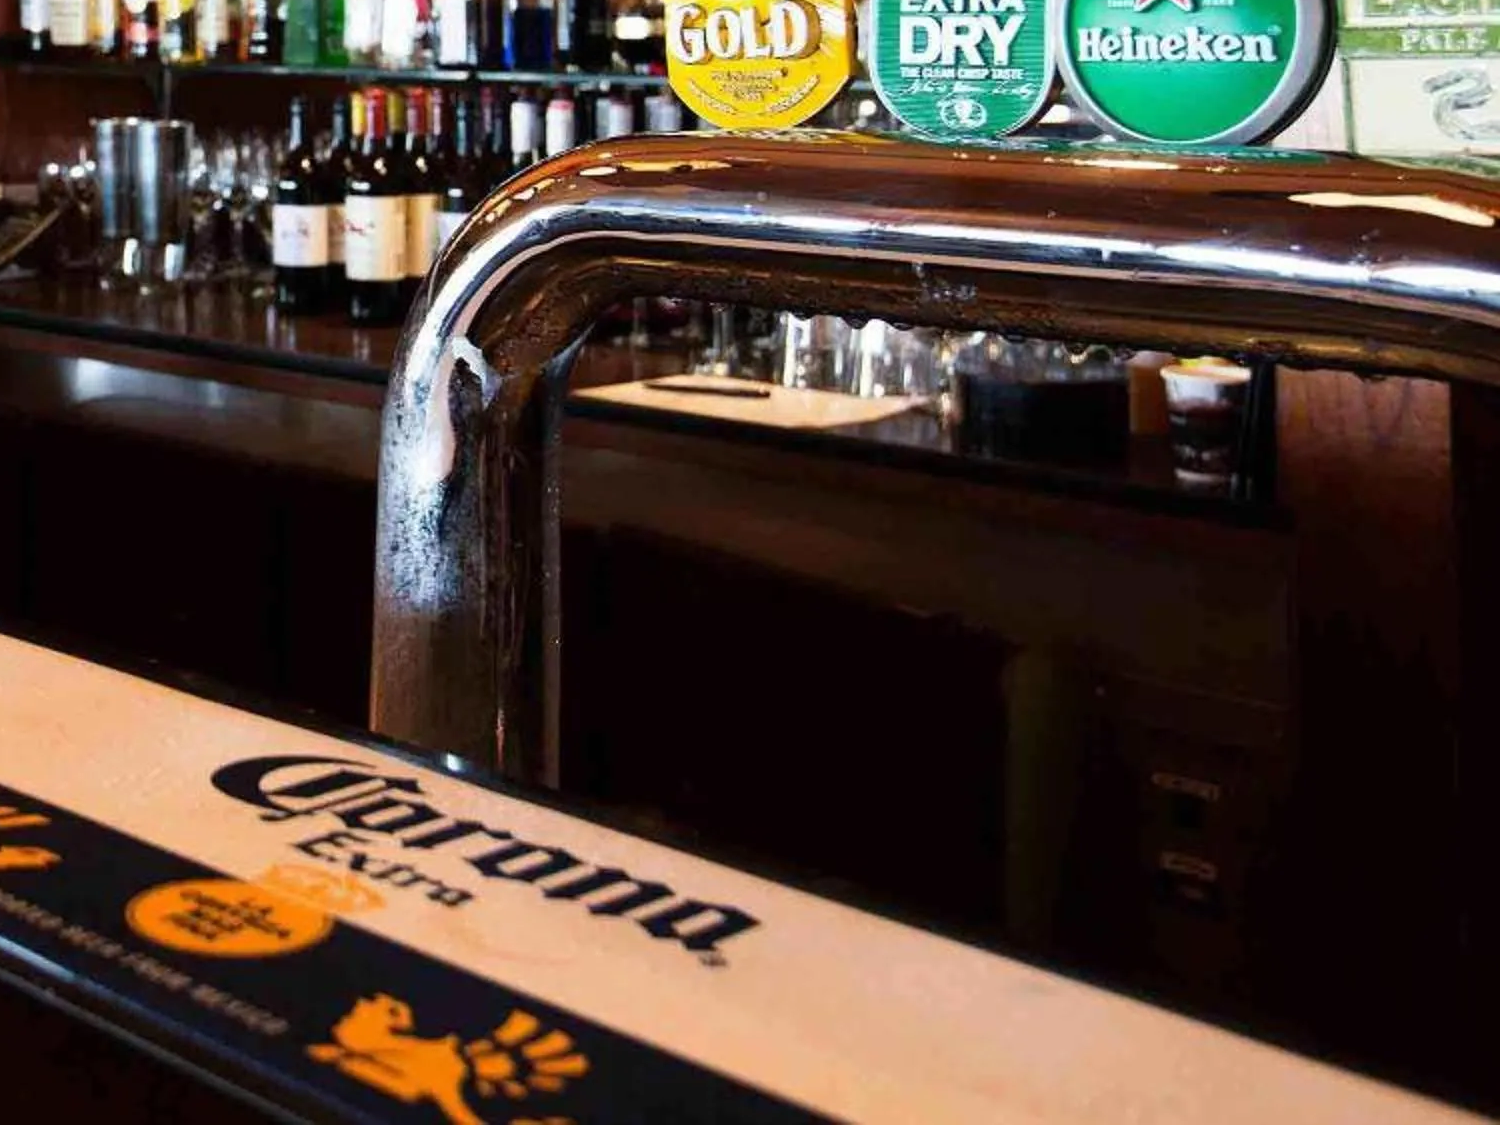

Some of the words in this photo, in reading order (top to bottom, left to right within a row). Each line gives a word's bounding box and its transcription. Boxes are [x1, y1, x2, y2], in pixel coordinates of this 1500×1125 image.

[669, 0, 810, 65] GOLD
[900, 15, 1027, 66] DRY
[1077, 26, 1278, 62] Heineken
[210, 754, 761, 952] Corona
[292, 830, 475, 908] Extra
